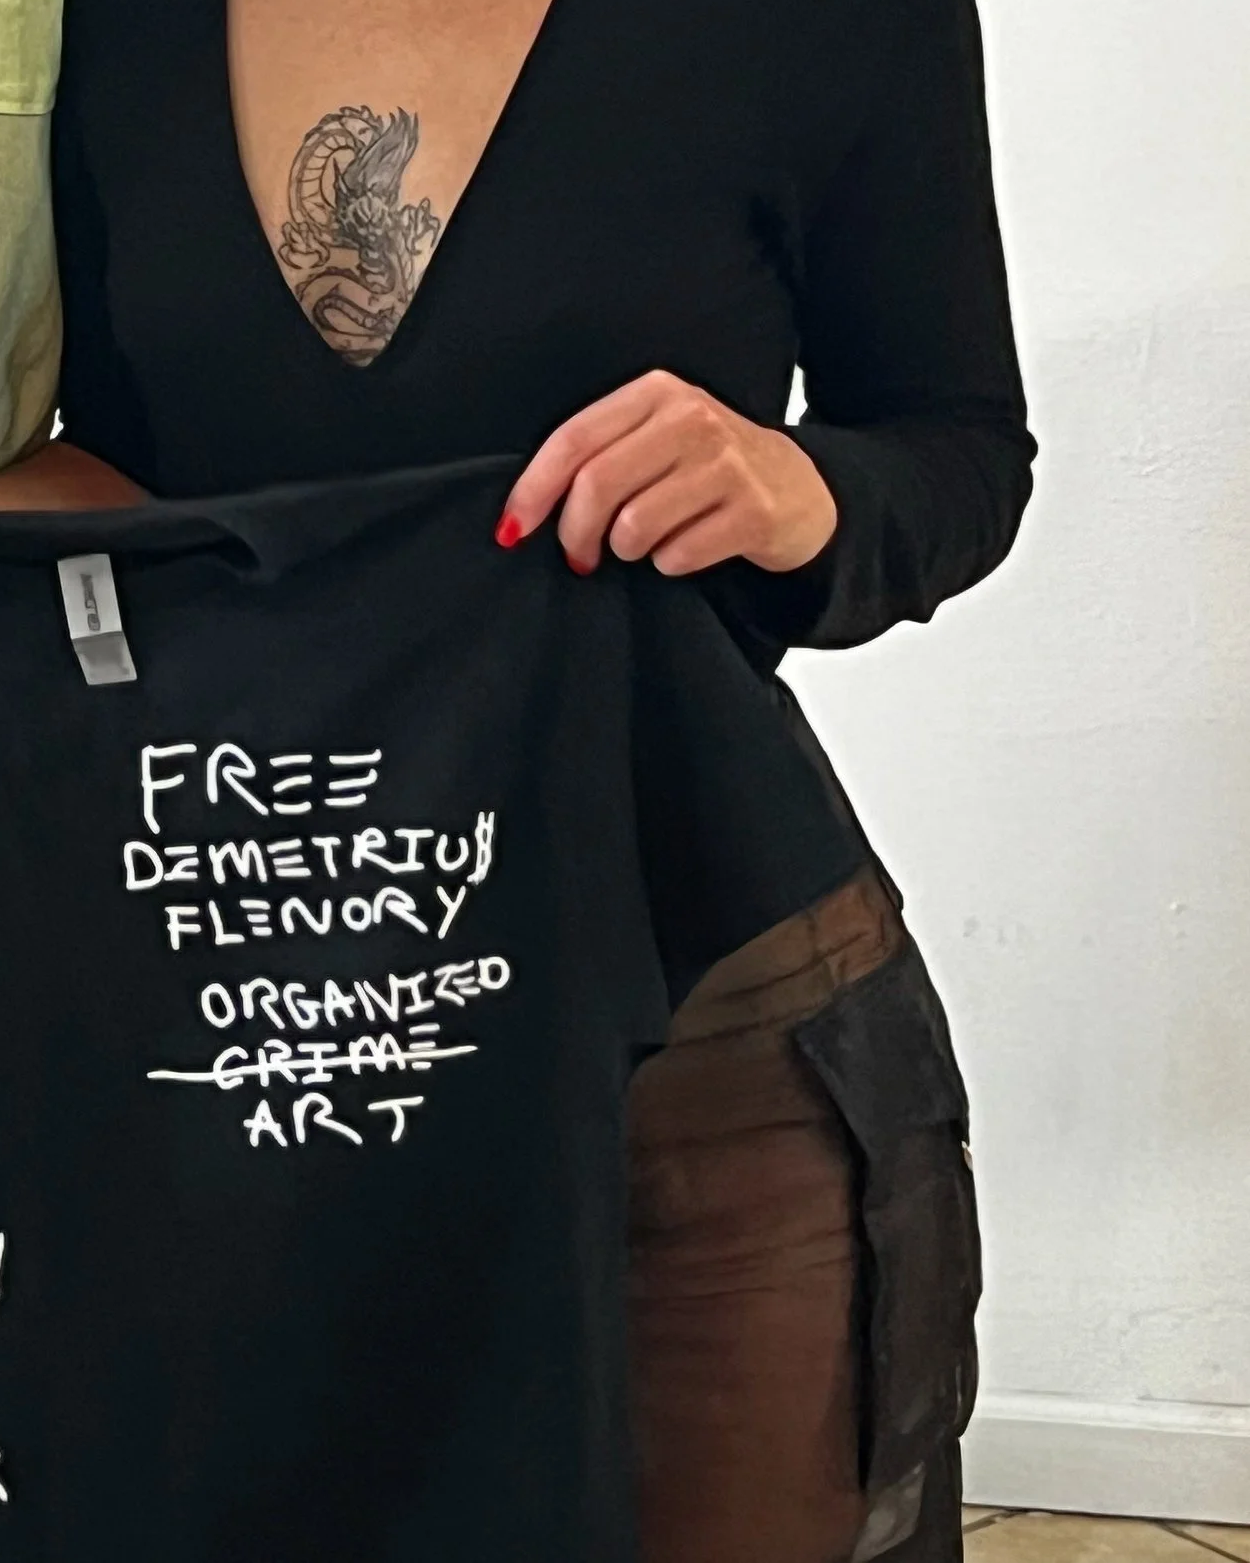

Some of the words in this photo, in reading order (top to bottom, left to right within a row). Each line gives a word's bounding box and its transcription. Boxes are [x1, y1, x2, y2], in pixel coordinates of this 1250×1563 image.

[141, 743, 383, 834] FREE
[164, 886, 467, 950] FLENORY
[201, 956, 511, 1030] ORGANIZED
[212, 1023, 440, 1090] CRIME
[243, 1092, 424, 1147] ART
